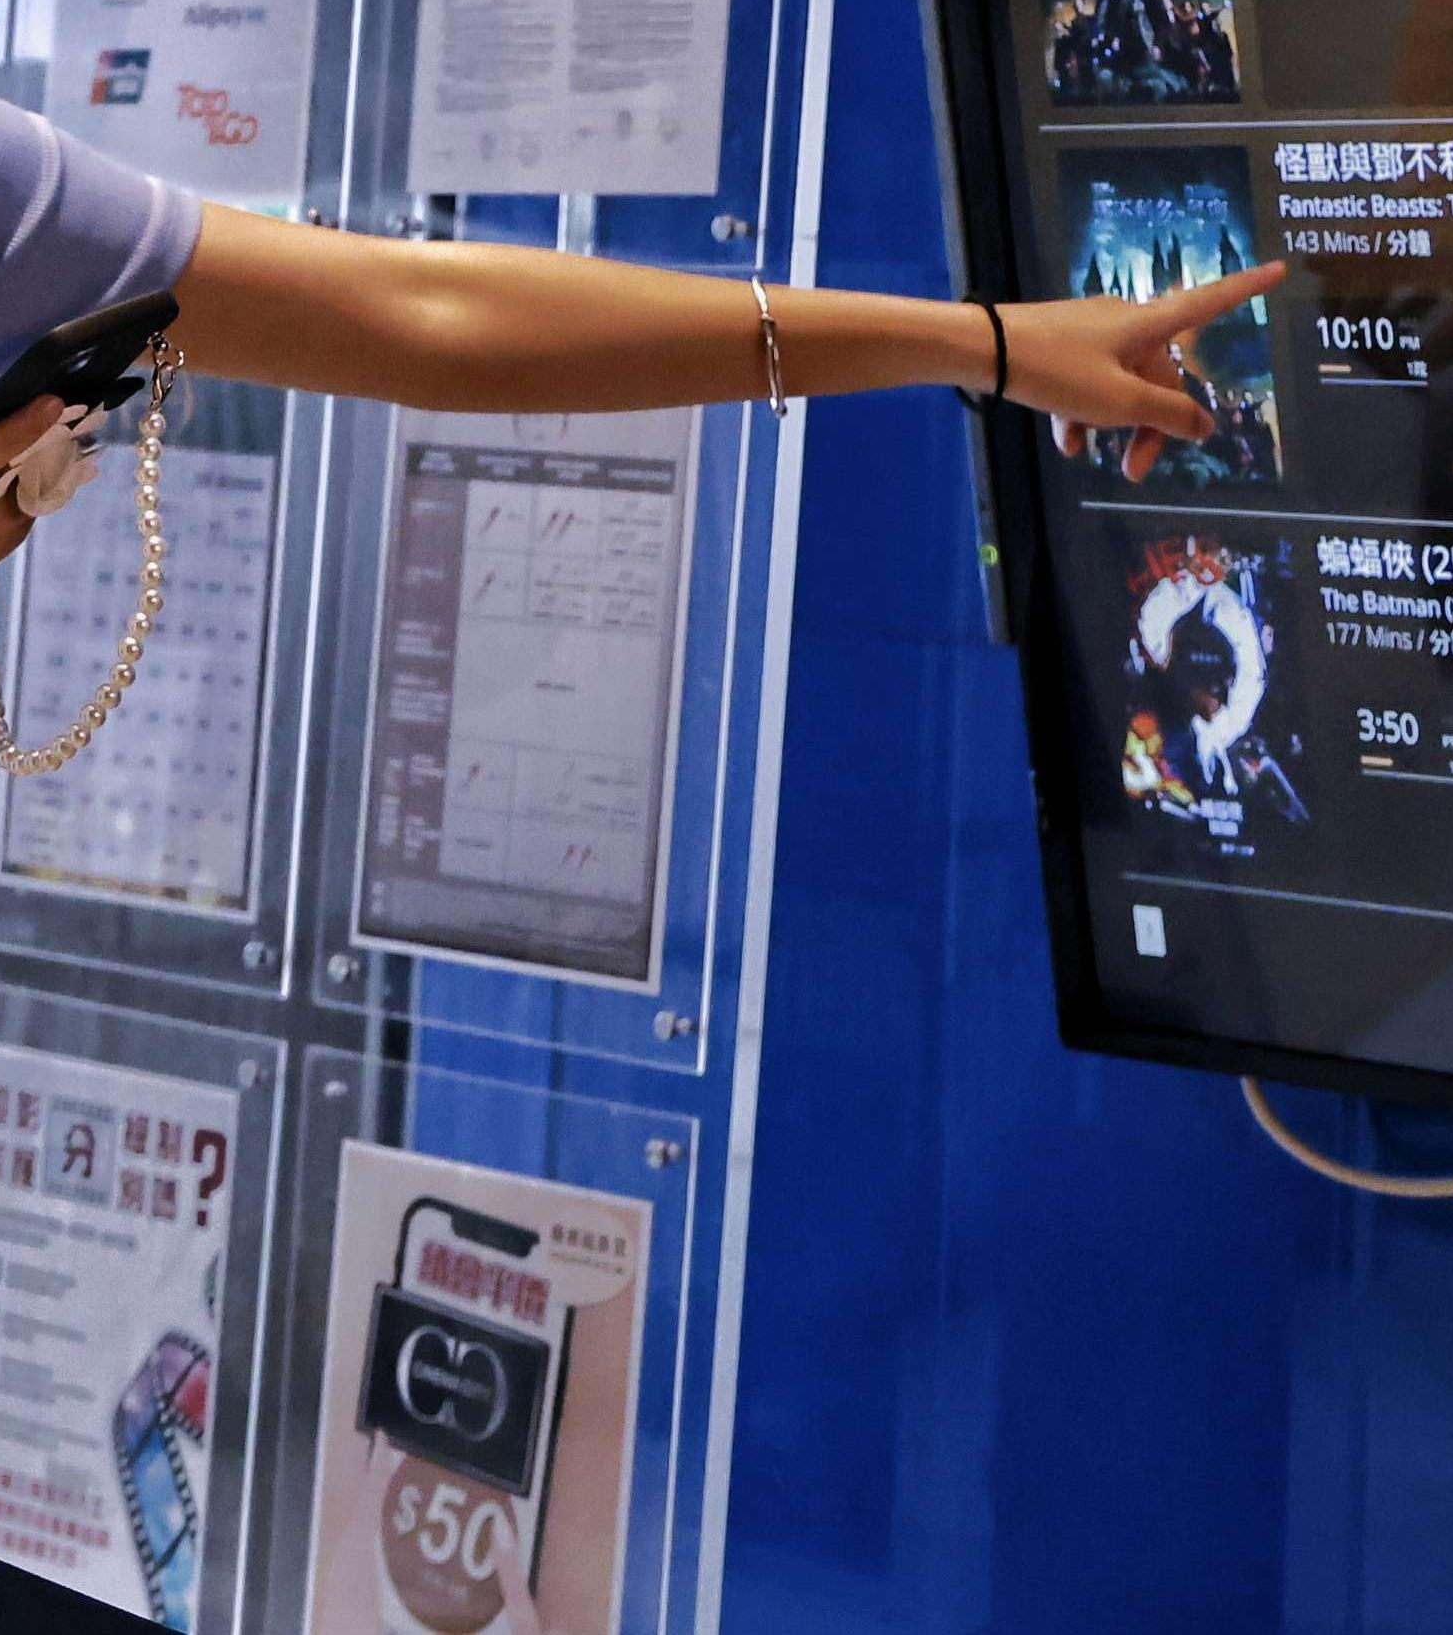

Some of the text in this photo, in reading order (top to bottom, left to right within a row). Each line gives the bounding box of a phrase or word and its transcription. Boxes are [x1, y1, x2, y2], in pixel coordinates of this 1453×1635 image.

[1278, 193, 1367, 218] Fantastic
[1371, 193, 1443, 218] Beasts:
[1283, 230, 1320, 253] 143
[1323, 230, 1372, 254] Mins
[1315, 315, 1394, 351] 10:10
[1316, 535, 1417, 581] 蝙蝠俠
[1319, 586, 1360, 614] The
[1362, 591, 1442, 621] Batman
[1326, 622, 1361, 646] 177
[1365, 625, 1413, 652] Mins
[1356, 706, 1420, 746] 3:50
[192, 1127, 228, 1227] ?
[394, 1482, 507, 1583] $50
